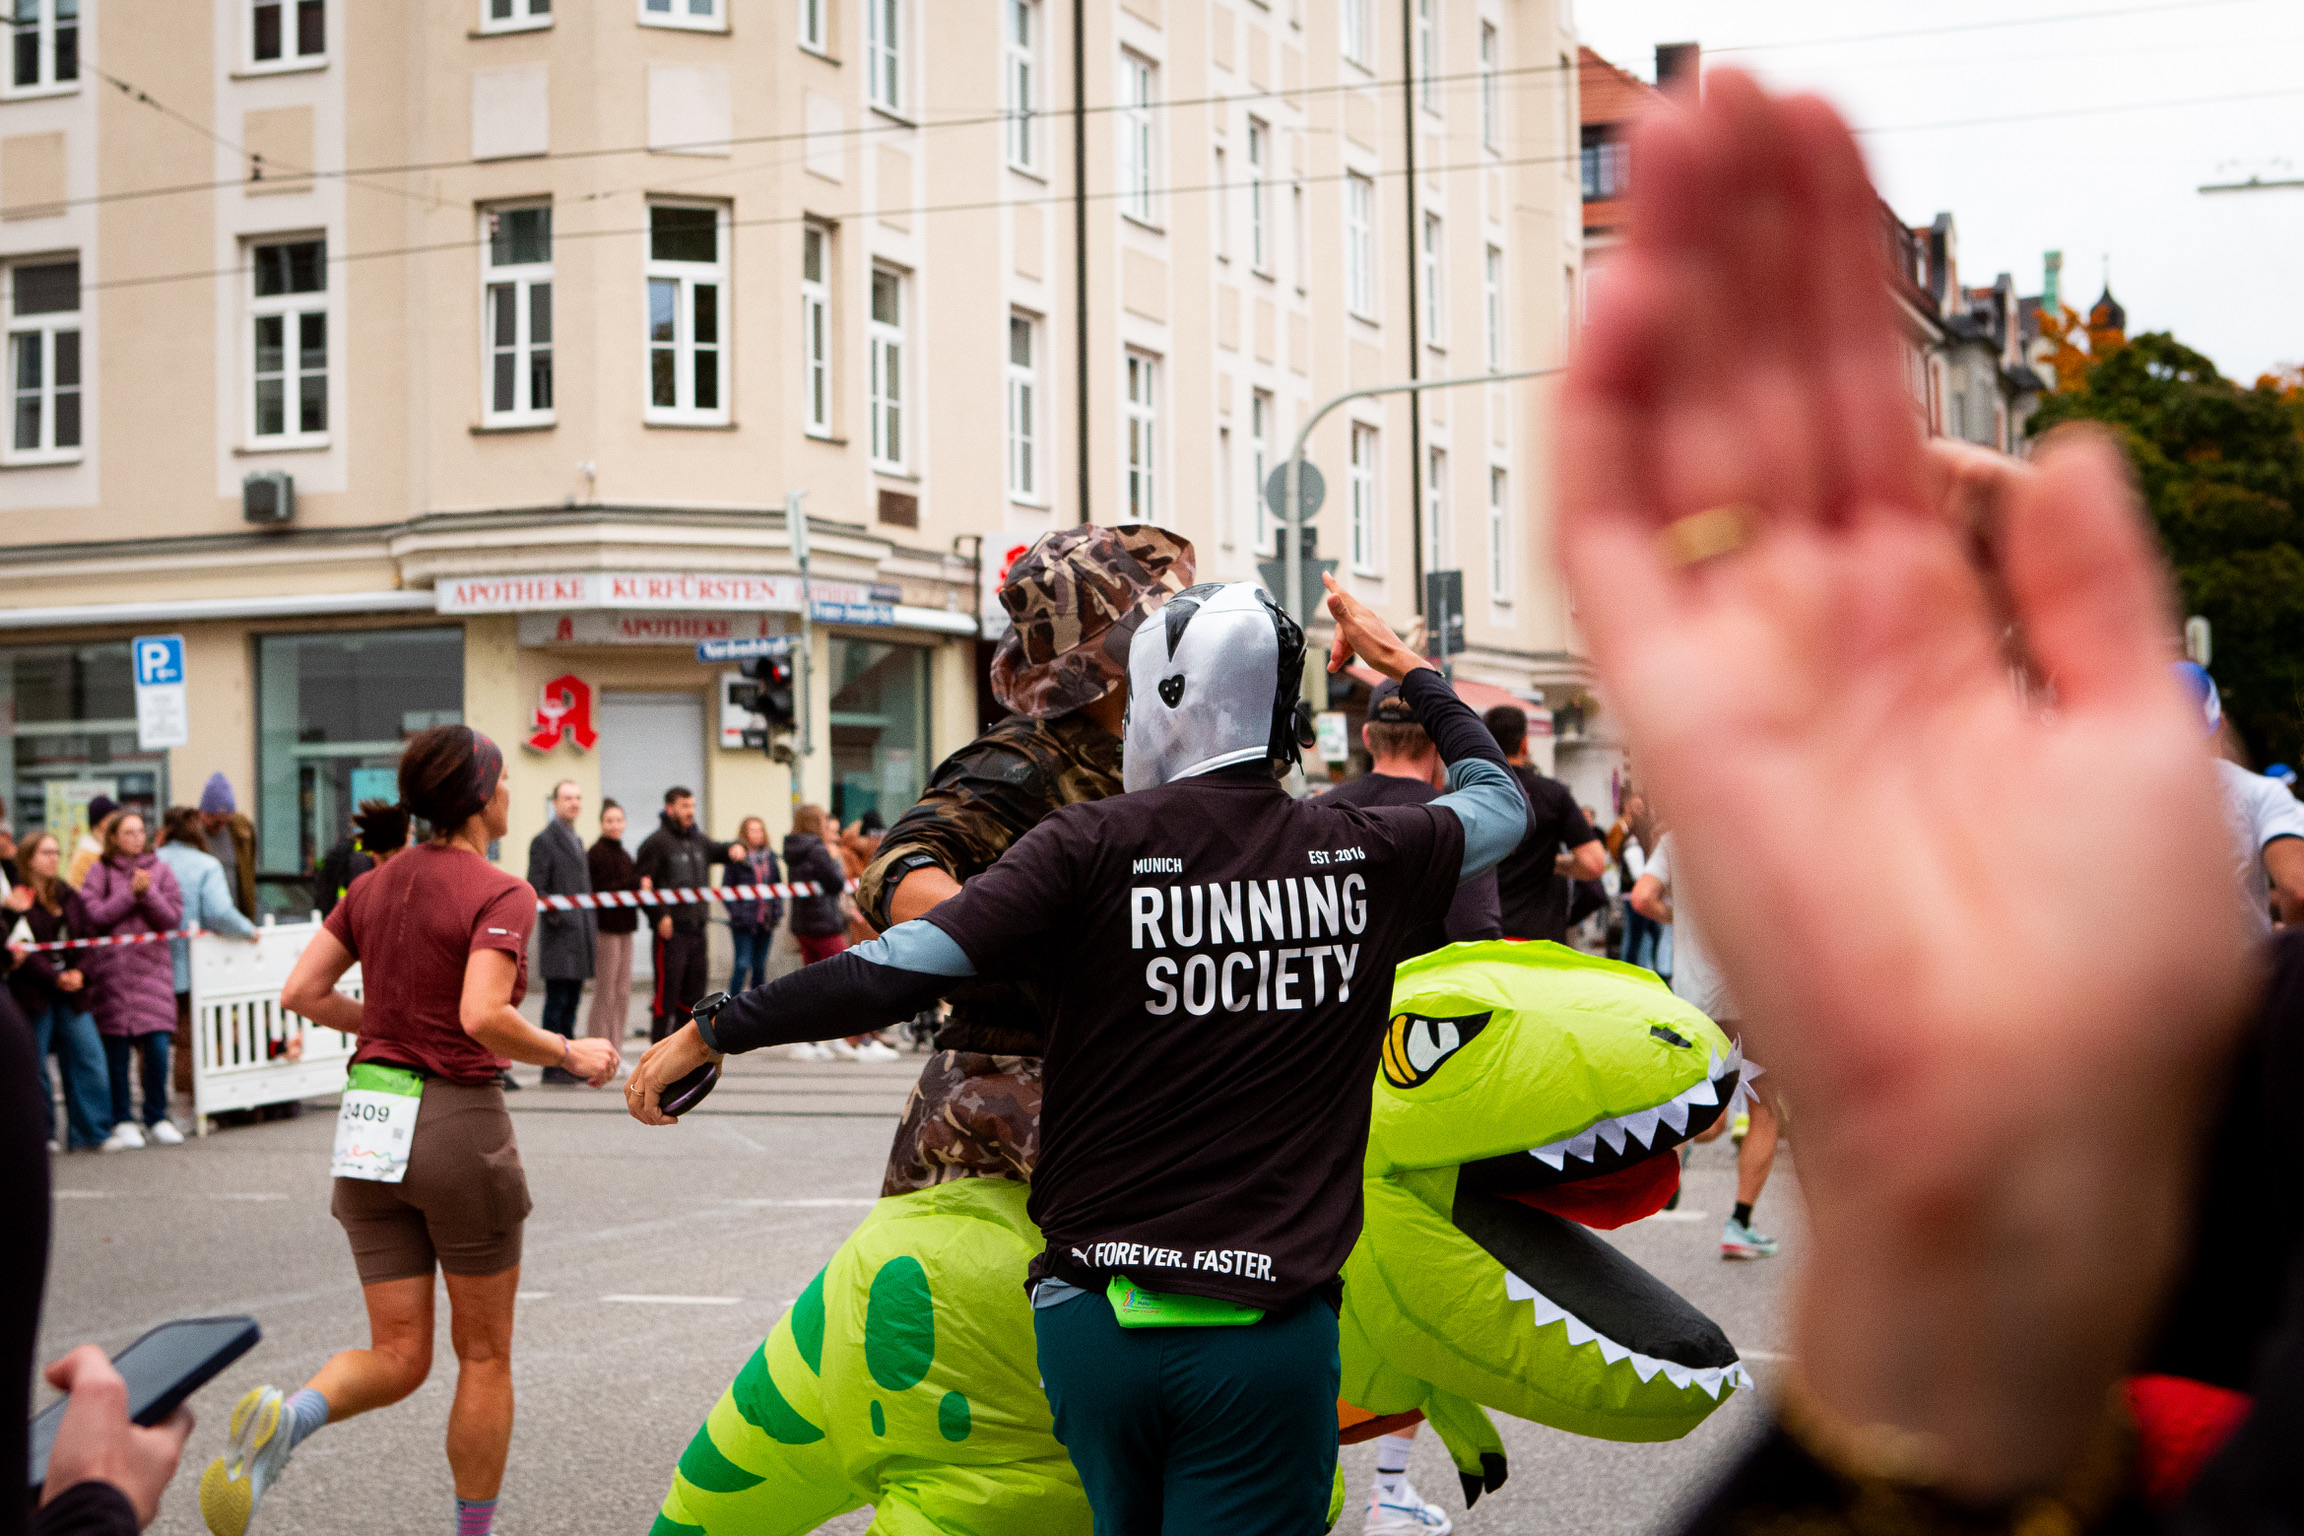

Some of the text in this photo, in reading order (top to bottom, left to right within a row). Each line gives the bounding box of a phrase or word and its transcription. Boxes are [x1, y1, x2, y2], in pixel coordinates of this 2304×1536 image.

[453, 577, 585, 604] APOTHEKE
[612, 573, 777, 600] KURFÜRSTEN
[621, 617, 732, 638] APOTHEKE
[142, 642, 171, 681] P
[1133, 857, 1183, 875] MUNICH
[1131, 873, 1367, 949] RUNNING
[1145, 943, 1360, 1016] SOCIETY
[1094, 1242, 1277, 1282] FOREVER. FASTER.
